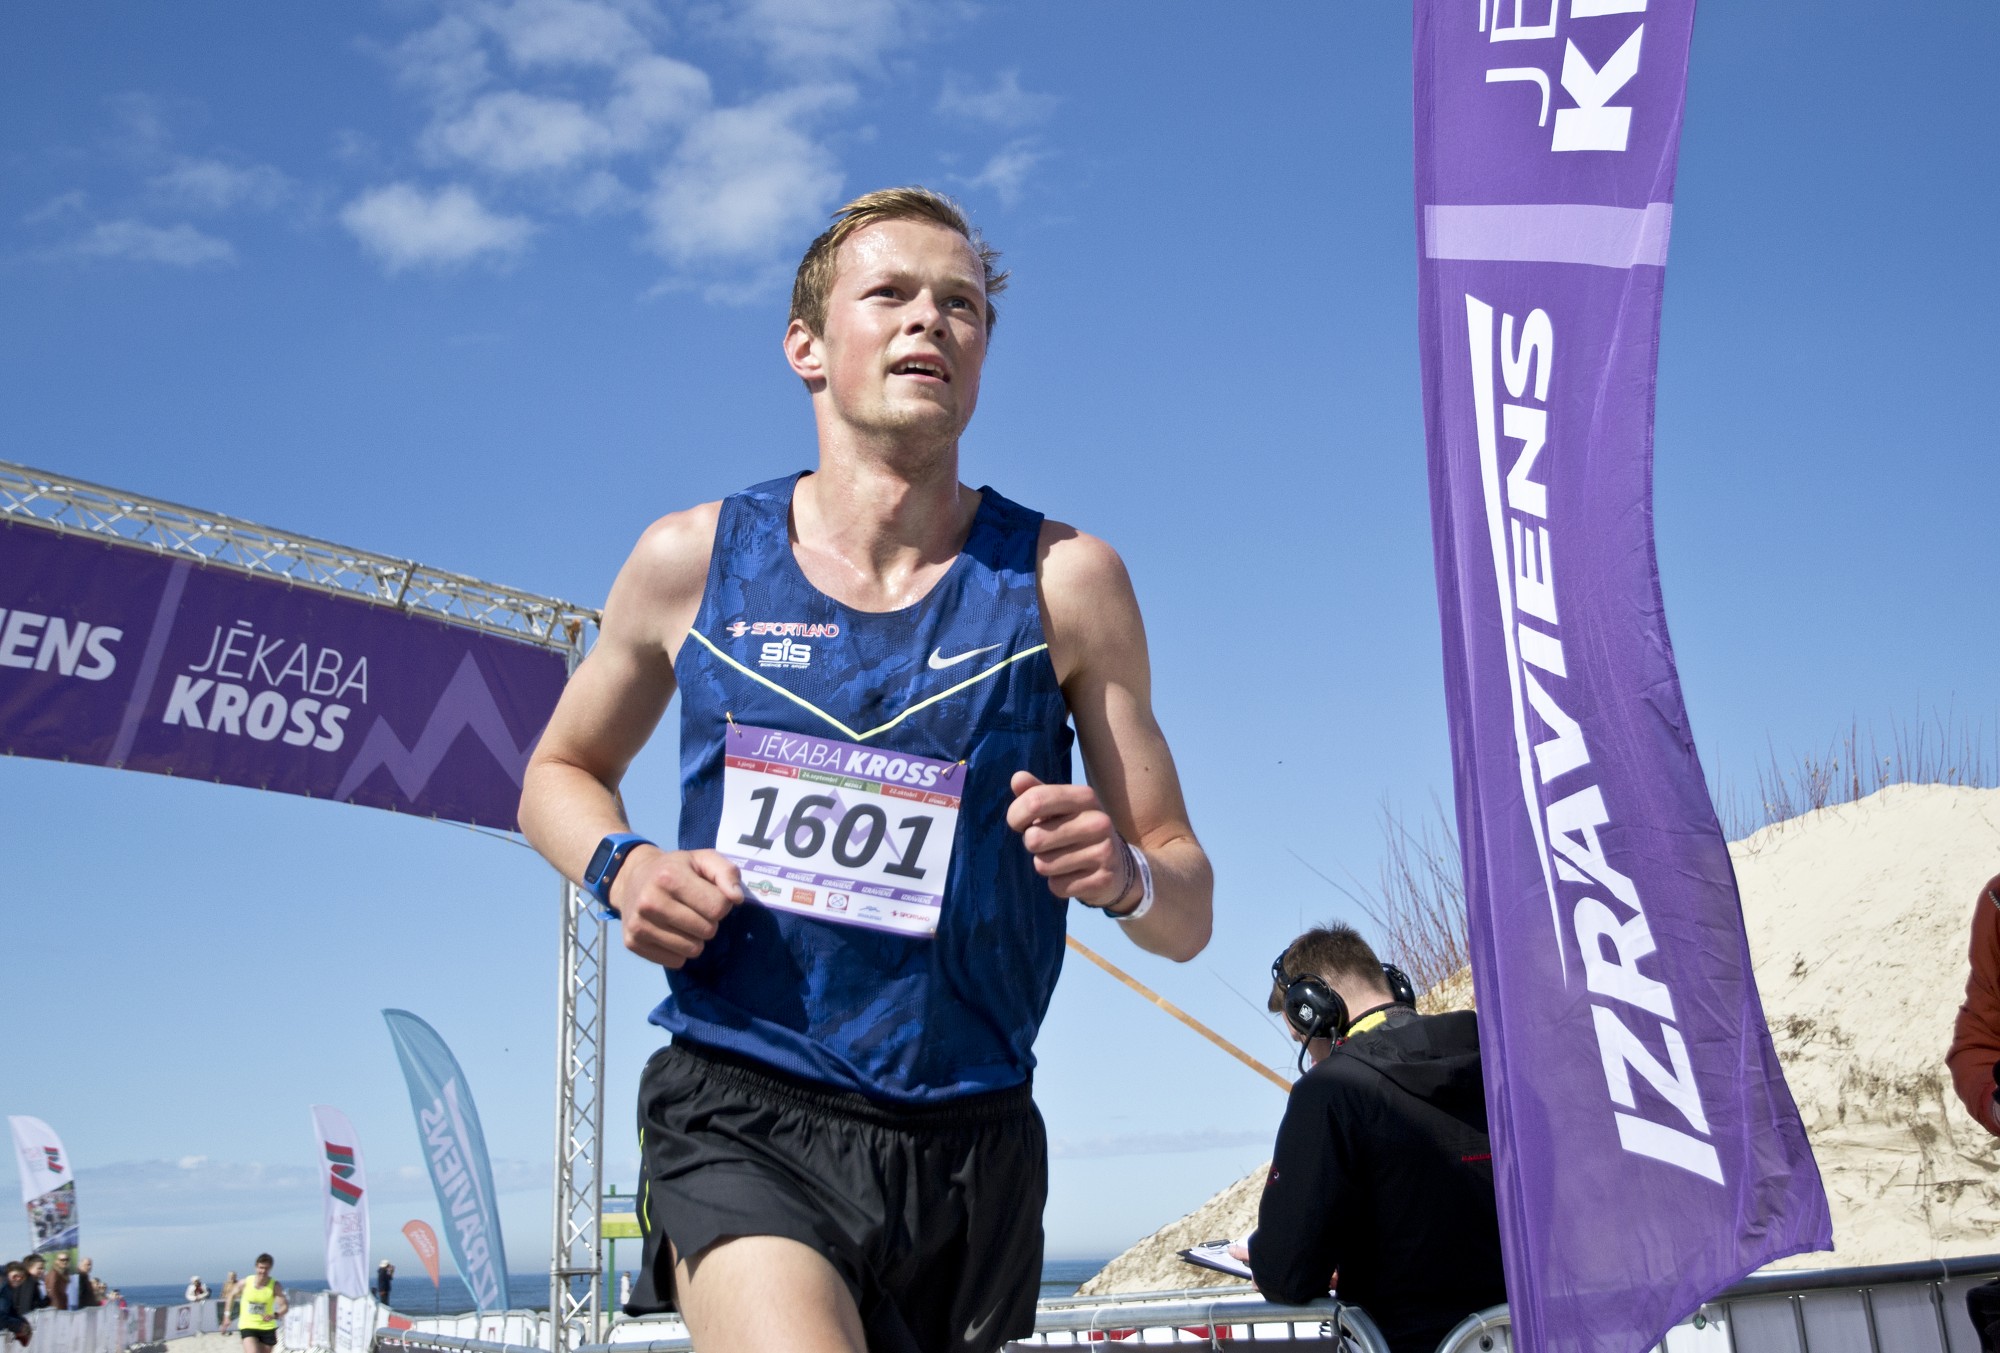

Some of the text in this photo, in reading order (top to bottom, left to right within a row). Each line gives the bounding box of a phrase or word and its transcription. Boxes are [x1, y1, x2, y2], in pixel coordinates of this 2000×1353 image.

[188, 620, 368, 704] JĒKABA
[750, 622, 840, 637] SPORTLAND
[163, 674, 351, 752] KROSS
[1499, 305, 1726, 1187] IZRAVIENS
[751, 732, 941, 787] JĒKABA KROSS
[737, 786, 934, 880] 1601
